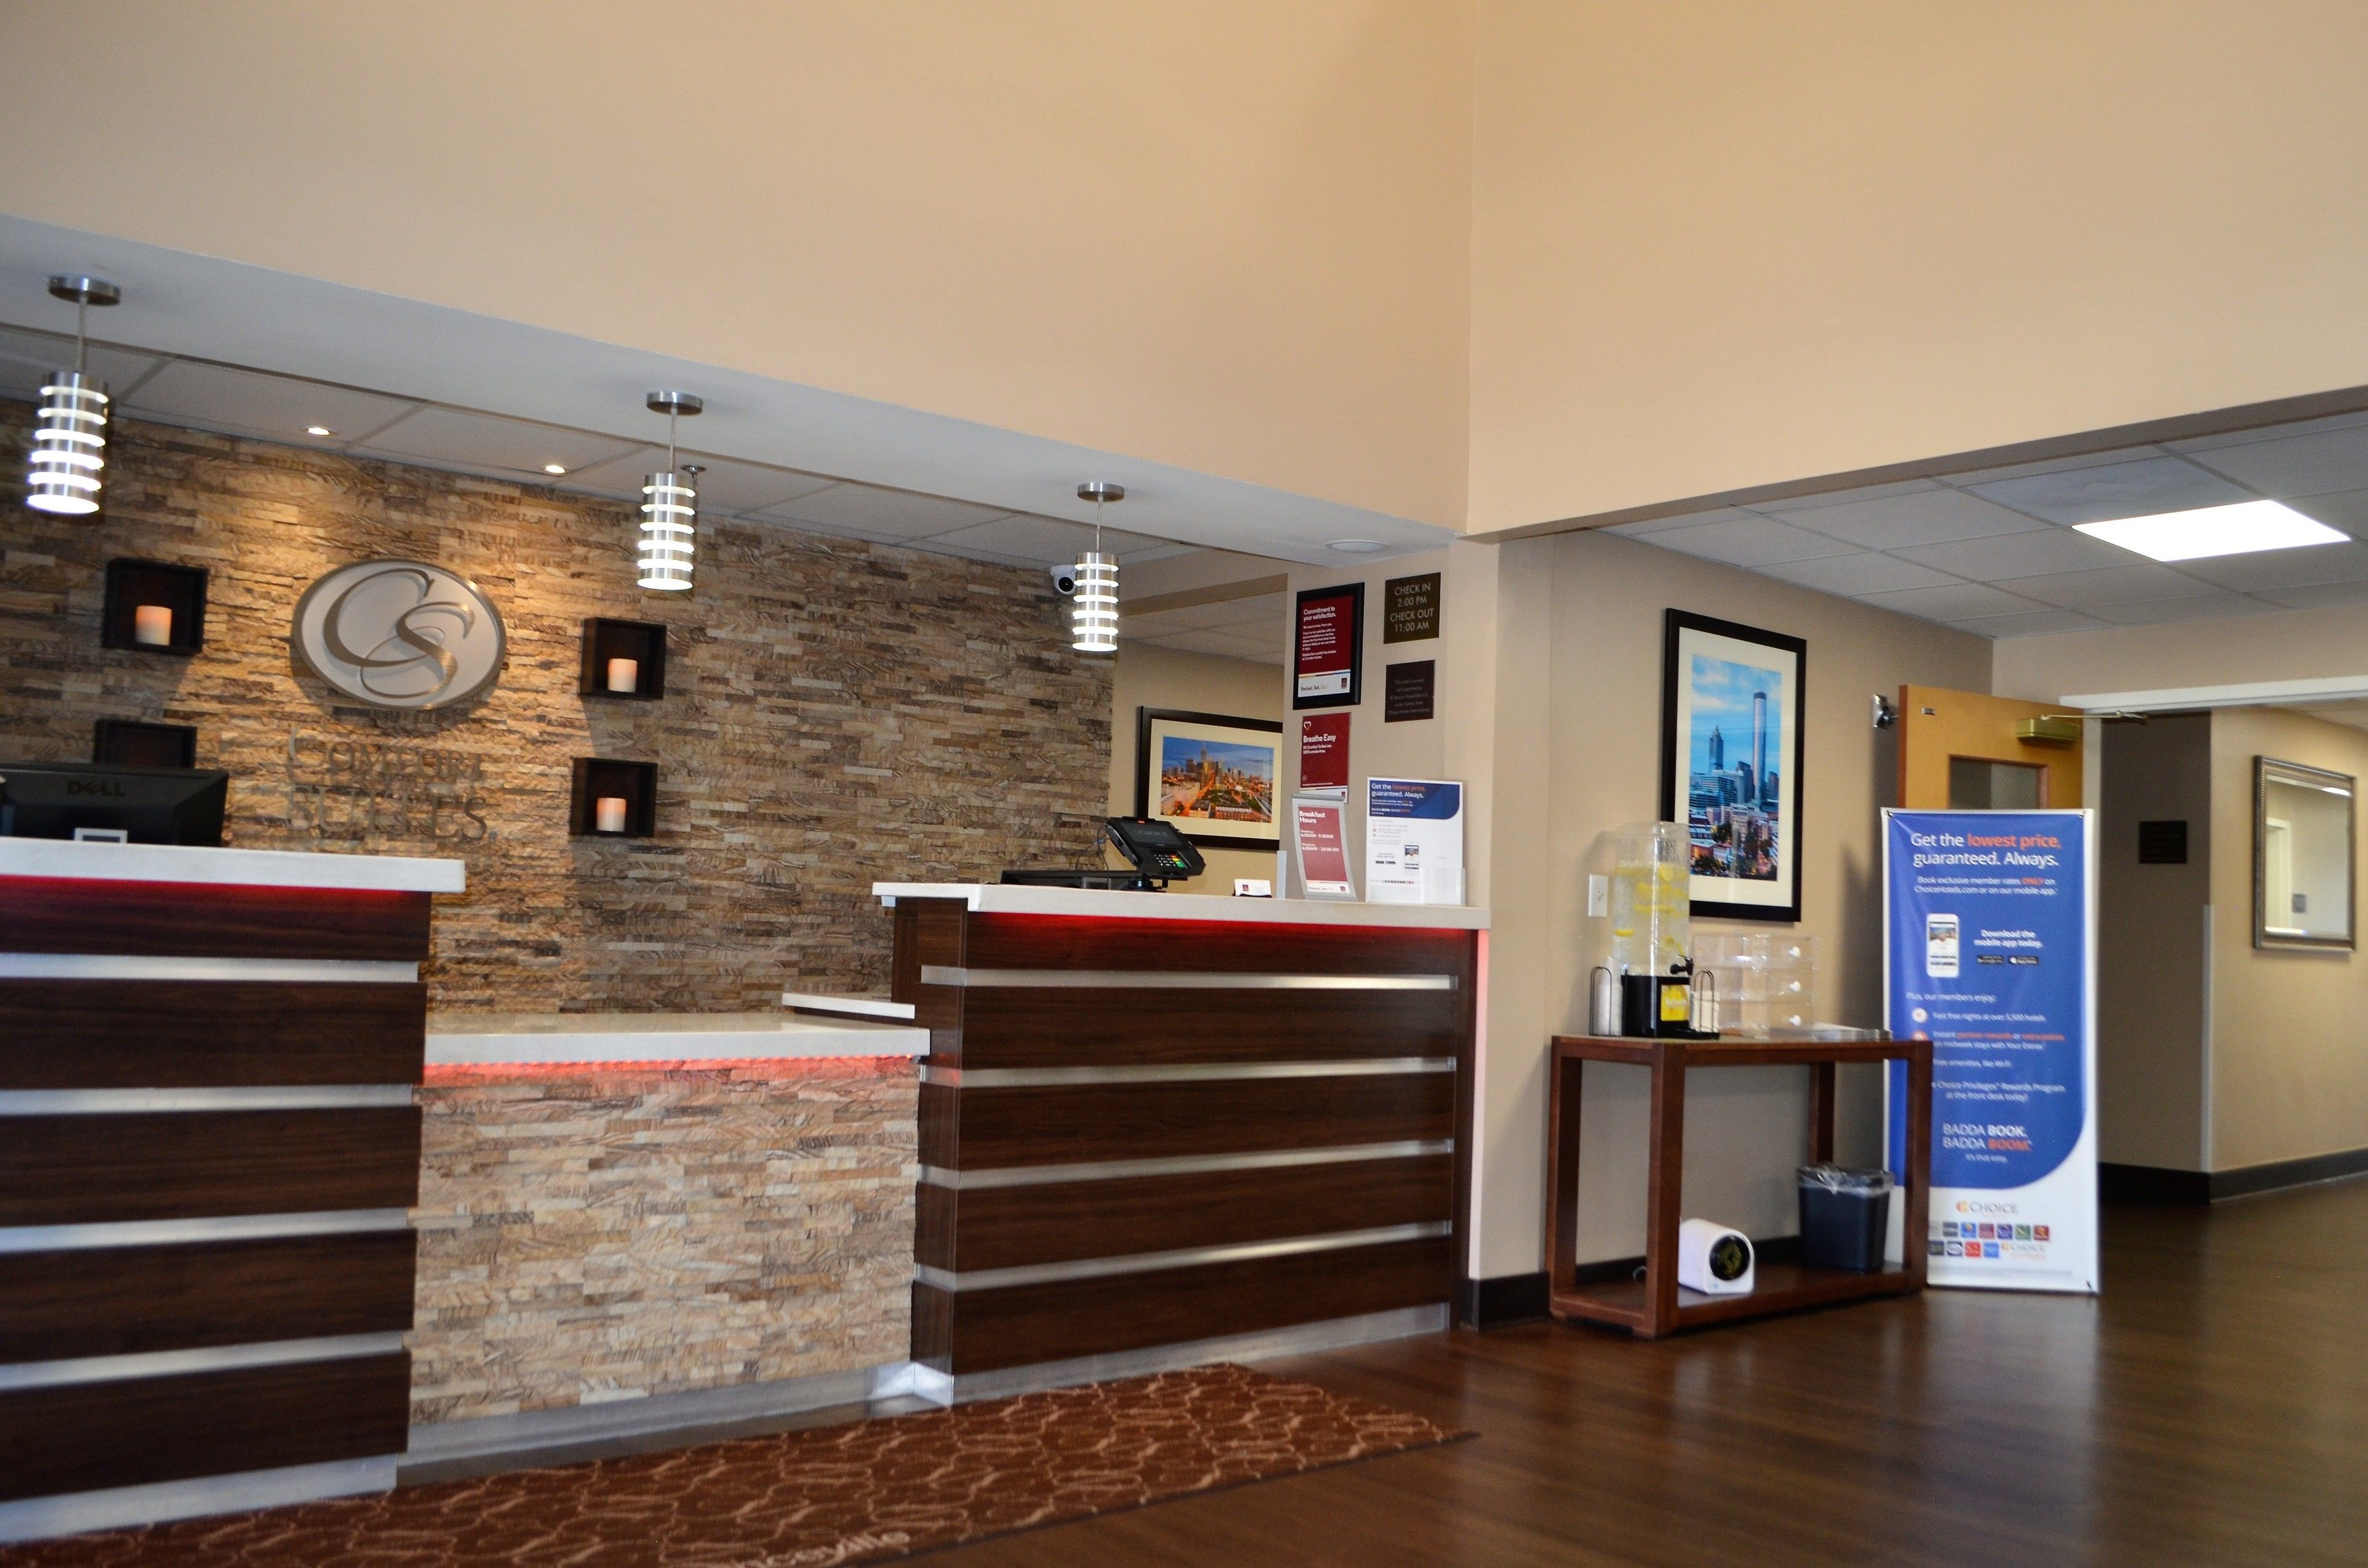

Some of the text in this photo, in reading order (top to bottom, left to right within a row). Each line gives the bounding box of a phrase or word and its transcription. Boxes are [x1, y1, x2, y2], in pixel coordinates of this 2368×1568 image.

[1395, 582, 1431, 596] CHECK IN
[1397, 596, 1427, 607] 2:00 PM
[1303, 607, 1330, 615] Commitment
[1390, 608, 1434, 622] CHECK OUT
[1395, 621, 1429, 633] 11:00 AM
[1303, 734, 1336, 742] Breathe Easy
[1404, 791, 1424, 799] Always.
[1299, 810, 1325, 818] Breakfast
[1910, 833, 1938, 847] Get
[1939, 833, 1964, 847] the
[1967, 832, 2017, 847] lowest
[1913, 852, 2058, 869] guaranteed. Always.
[1917, 876, 1936, 884] Book
[1936, 876, 1969, 884] exclusive
[1969, 876, 2001, 885] member
[2013, 886, 2039, 895] mobile
[1981, 929, 2036, 938] Download the
[1973, 938, 2002, 946] mobile
[2002, 940, 2018, 948] app
[1943, 1123, 1986, 1136] BADDA
[1943, 1136, 1987, 1149] BADDA
[1970, 1202, 2018, 1213] CHOICE
